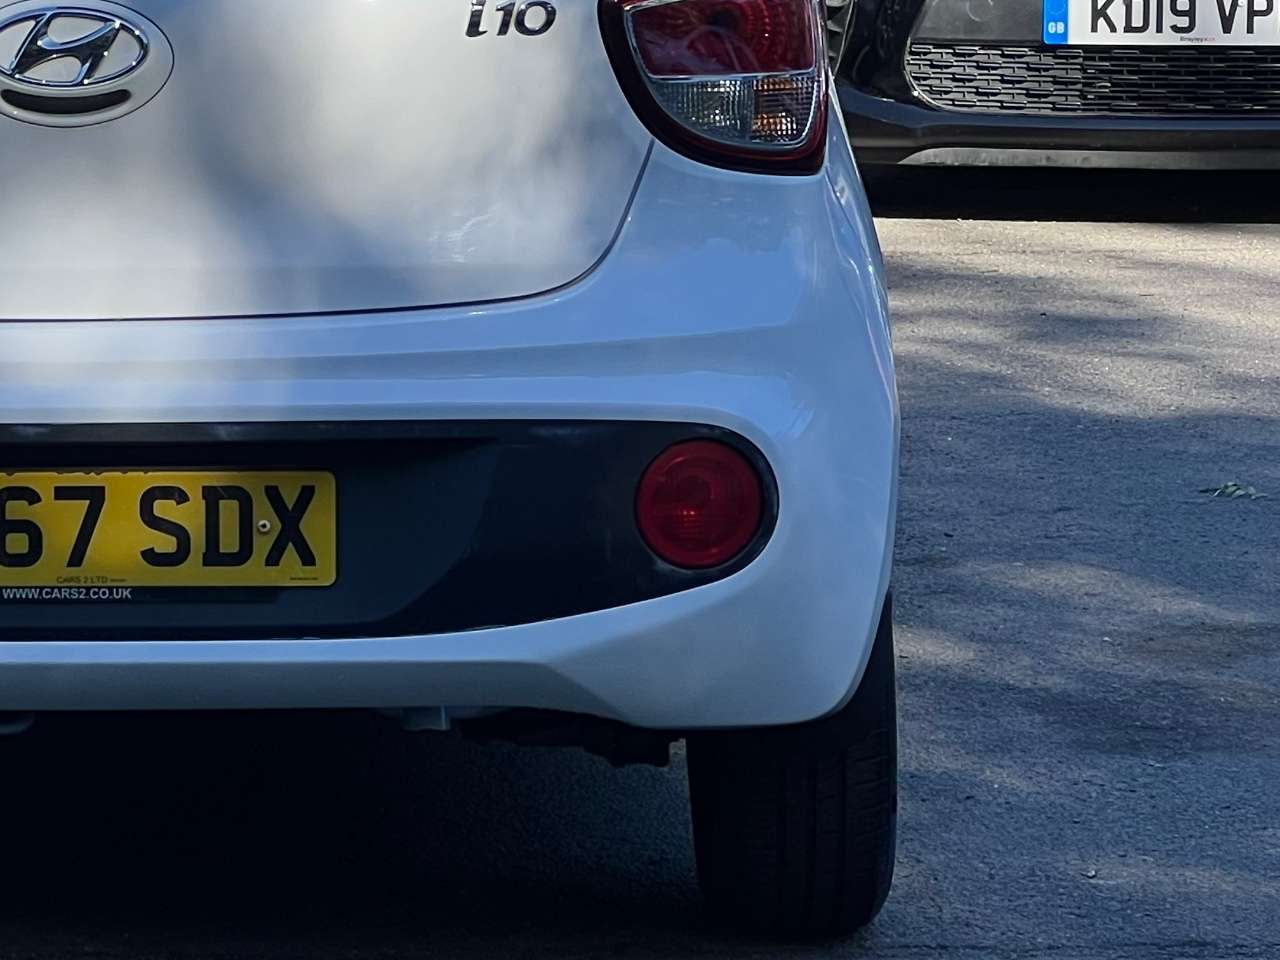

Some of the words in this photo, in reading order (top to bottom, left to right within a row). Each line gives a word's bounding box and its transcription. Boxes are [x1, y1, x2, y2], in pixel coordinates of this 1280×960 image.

[1048, 21, 1064, 34] GB
[138, 485, 318, 569] SDX
[2, 588, 132, 600] WWW.CARS2.CO.UK
